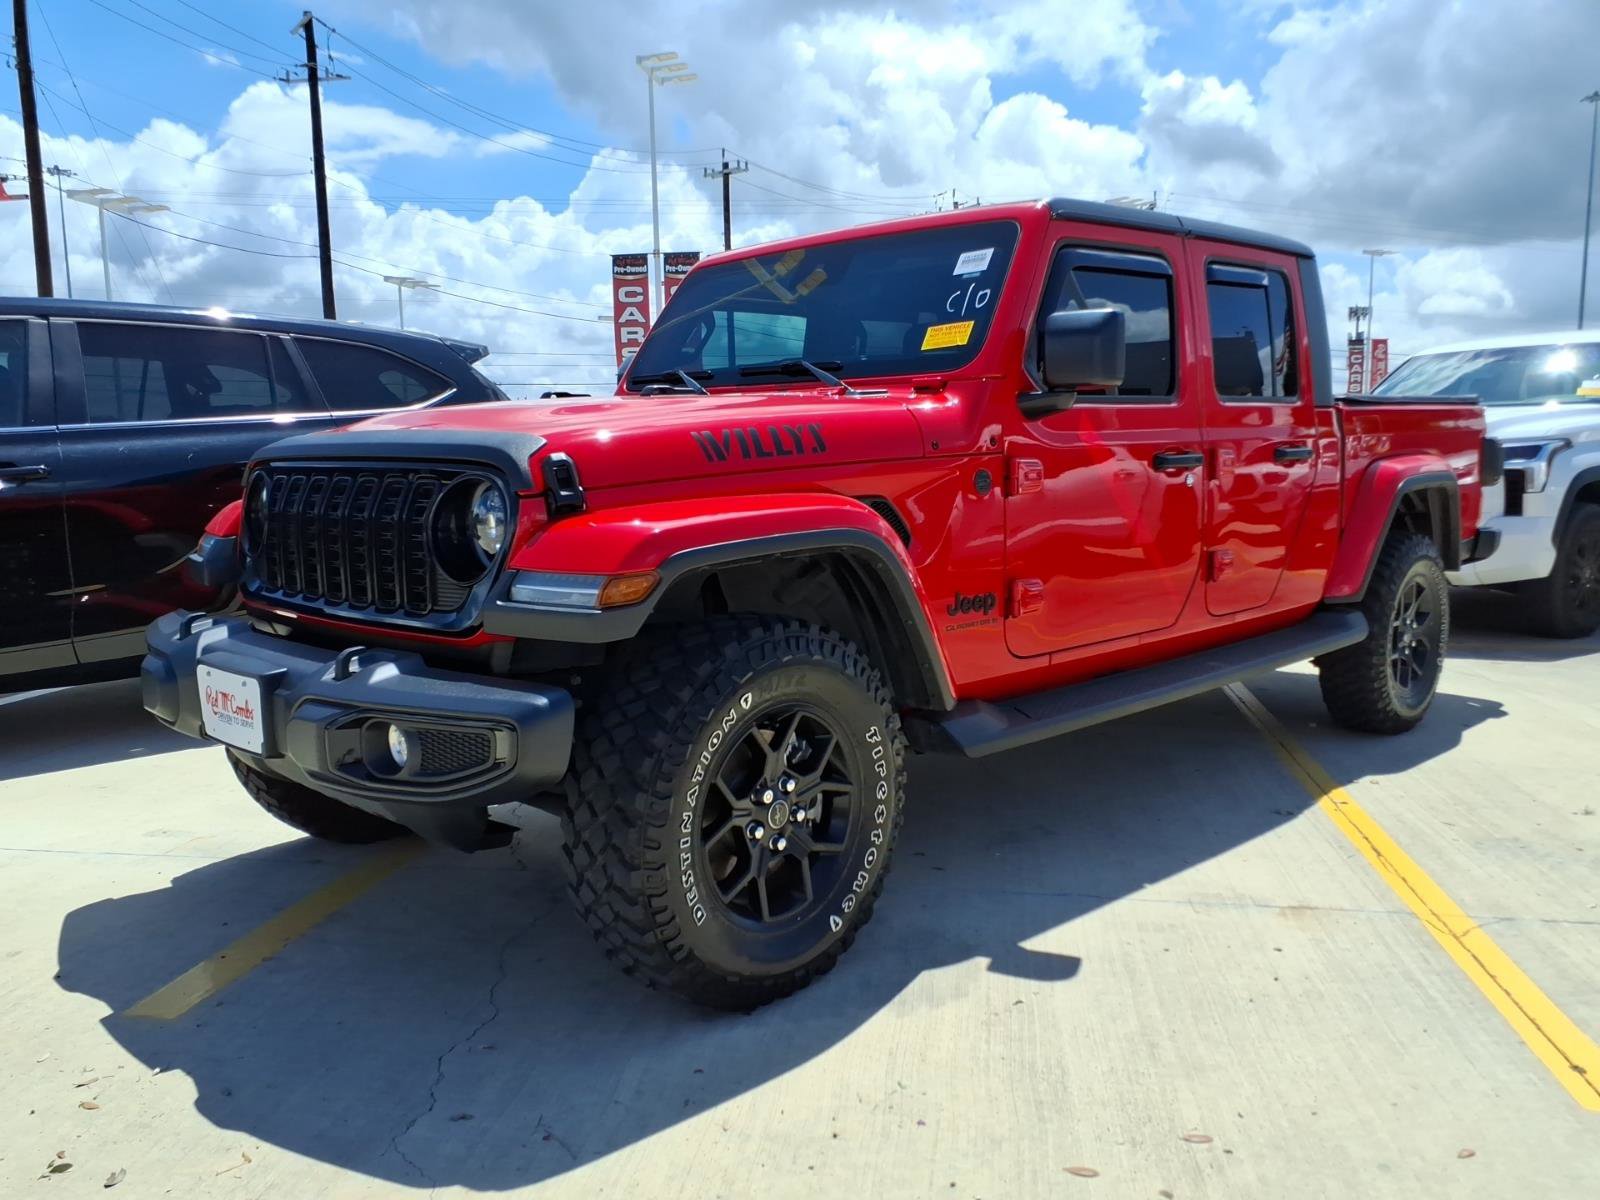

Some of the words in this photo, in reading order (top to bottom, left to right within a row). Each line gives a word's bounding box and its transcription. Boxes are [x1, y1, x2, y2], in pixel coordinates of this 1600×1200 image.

[614, 264, 647, 273] Pre-Owned
[666, 264, 693, 273] Pre-Own
[1349, 354, 1362, 392] CARS
[690, 423, 827, 462] WILLYS
[947, 592, 996, 616] Jeep
[206, 685, 219, 713] Red
[219, 691, 255, 720] McCombs
[233, 716, 240, 725] TO
[680, 709, 737, 926] DESTINATION
